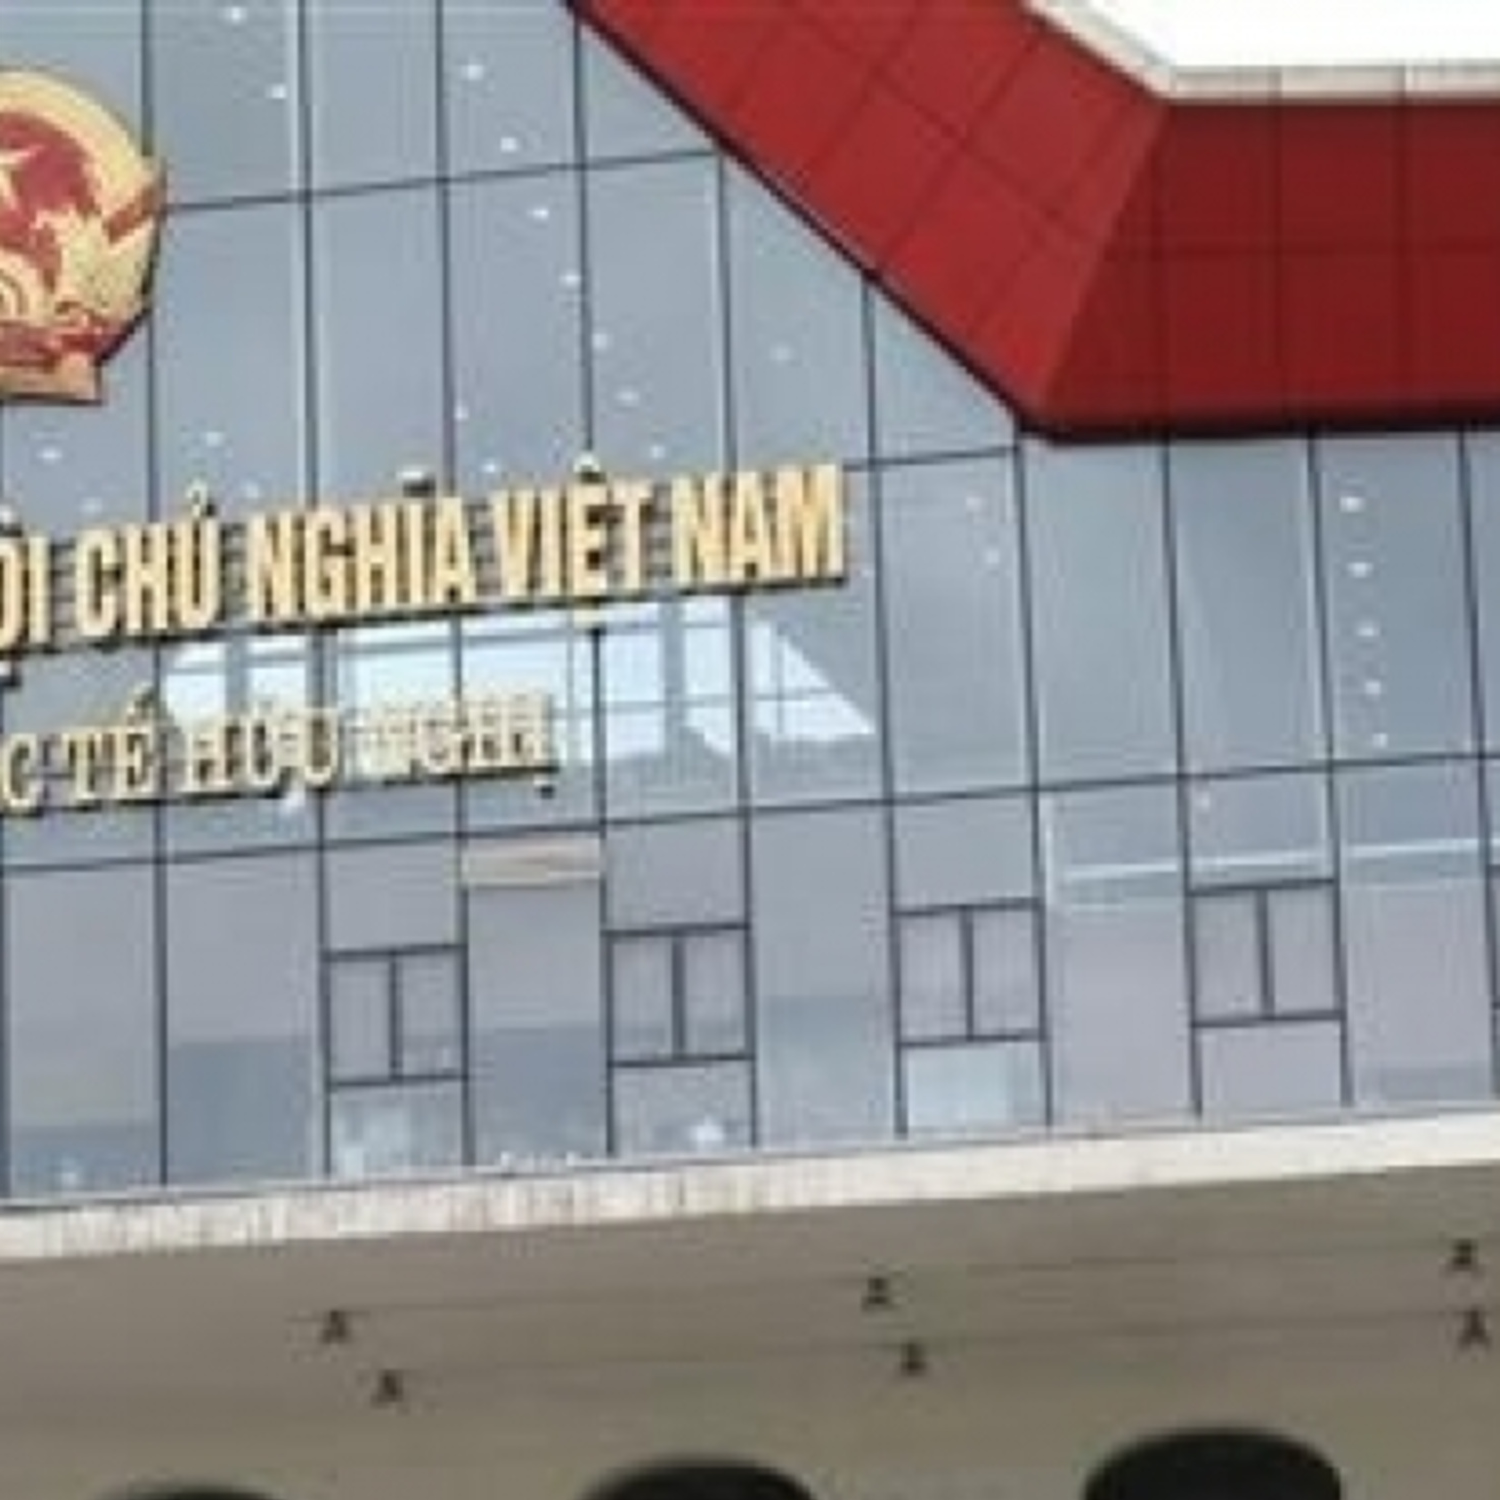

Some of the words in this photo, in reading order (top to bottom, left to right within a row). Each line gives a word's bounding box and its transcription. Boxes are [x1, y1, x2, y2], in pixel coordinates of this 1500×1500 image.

[75, 480, 222, 638] CHỦ
[247, 467, 477, 623] NGHĨA
[491, 453, 655, 626] VIỆT
[670, 463, 846, 587] NAM
[62, 682, 160, 803] TẾ
